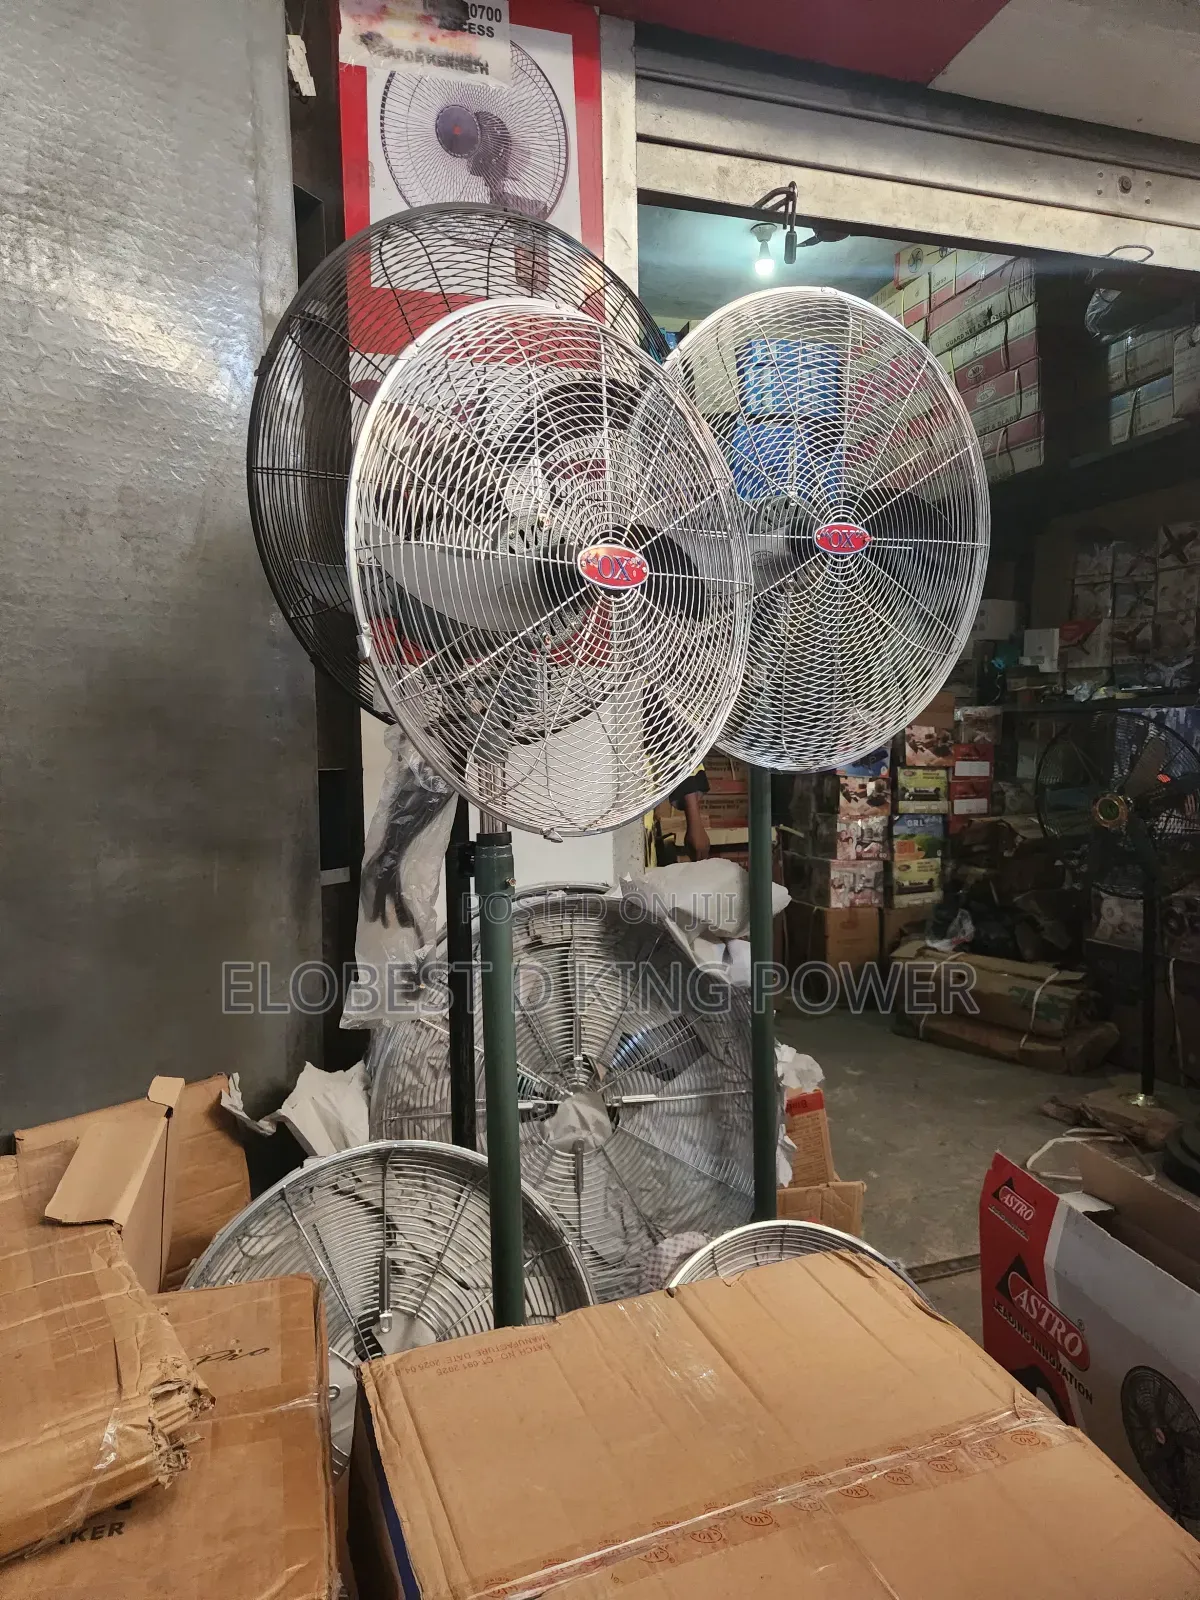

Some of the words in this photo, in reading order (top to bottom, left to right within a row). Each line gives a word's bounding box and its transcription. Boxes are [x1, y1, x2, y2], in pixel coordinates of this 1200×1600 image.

[1000, 1192, 1034, 1222] ASTRO
[1013, 1289, 1083, 1358] ASTRO
[475, 1334, 546, 1357] MANUFACTURE
[519, 1342, 551, 1356] BATCH
[60, 1521, 126, 1545] KER
